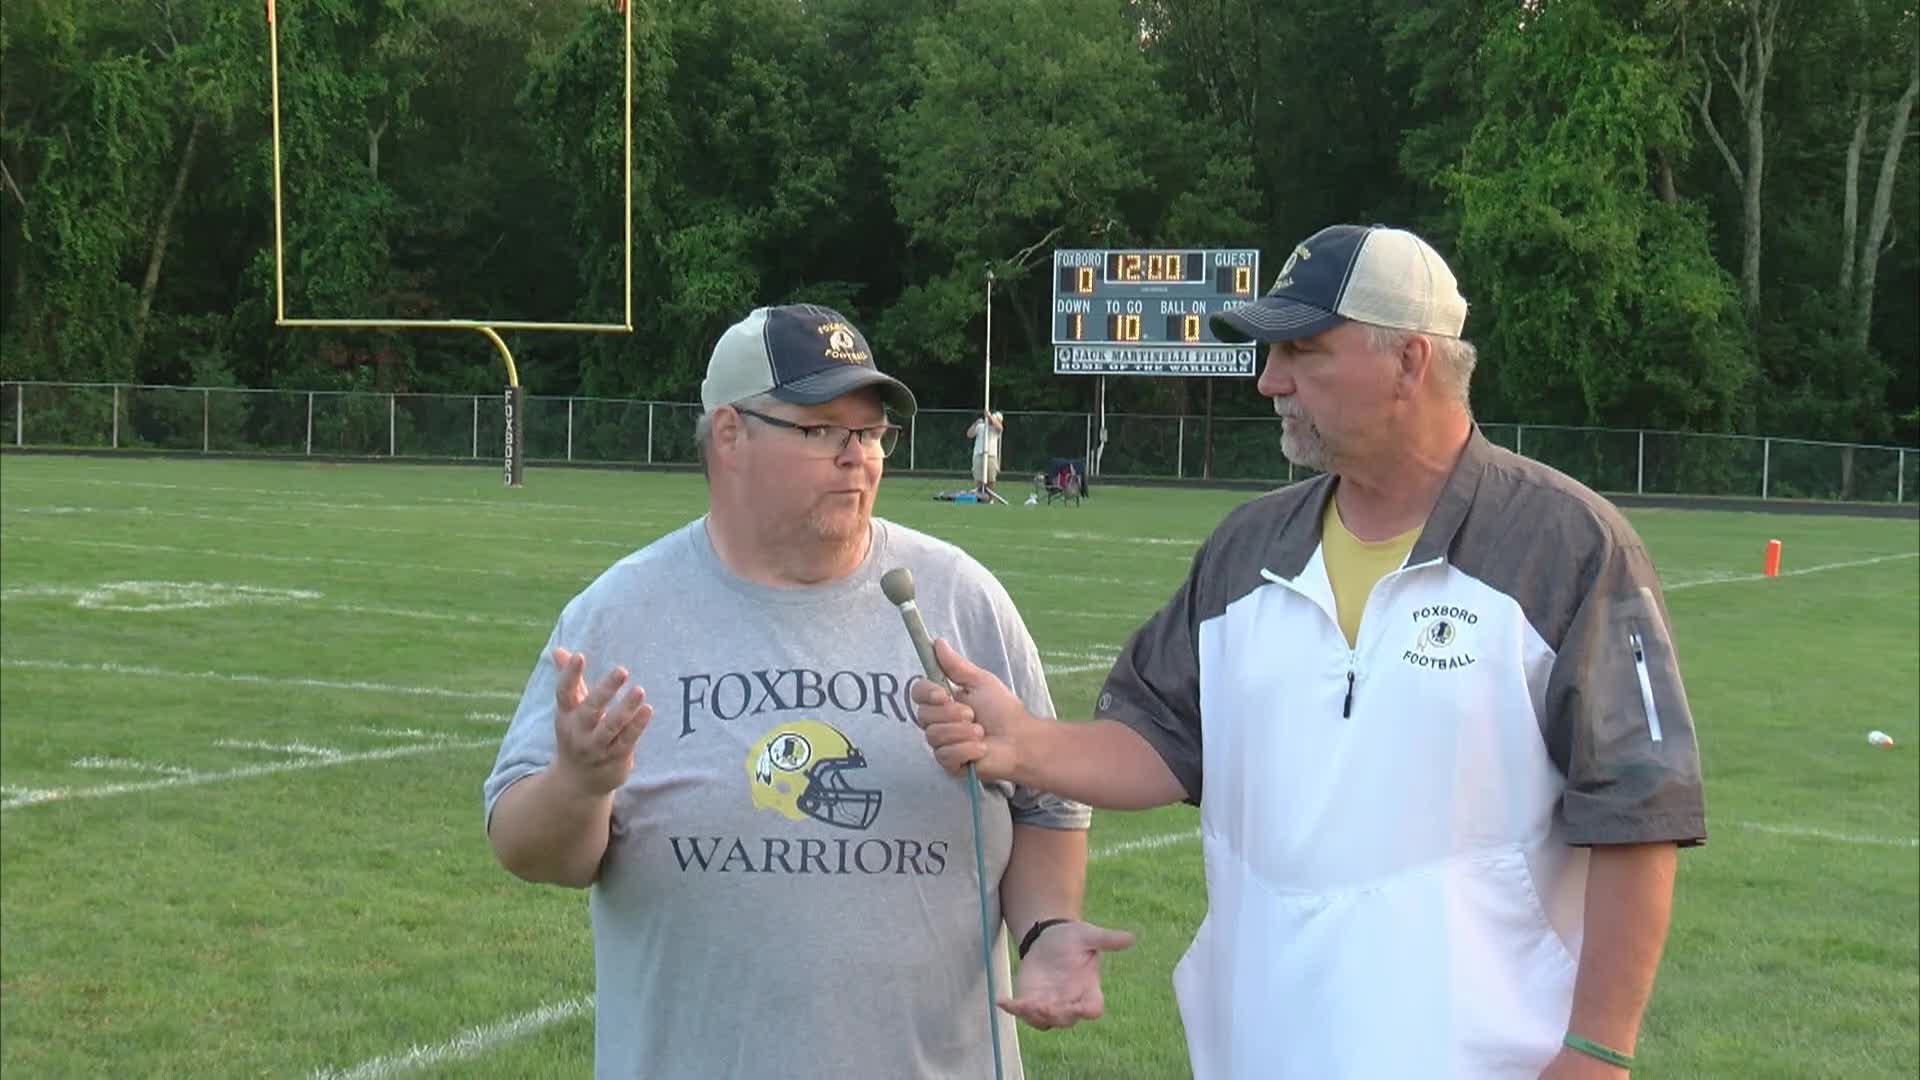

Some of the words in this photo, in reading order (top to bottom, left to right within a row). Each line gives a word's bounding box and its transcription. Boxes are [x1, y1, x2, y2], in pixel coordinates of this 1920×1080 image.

[1057, 253, 1101, 266] FOXBORO
[1117, 255, 1181, 280] 12:00
[1215, 253, 1253, 266] GUEST
[1079, 267, 1093, 293] 0
[1236, 267, 1250, 293] 0
[1057, 300, 1090, 313] DOWN
[1106, 300, 1119, 313] TO
[1127, 300, 1143, 313] GO
[1160, 300, 1185, 314] BALL
[1192, 300, 1206, 314] ON
[1075, 315, 1082, 340] 1
[1117, 315, 1140, 340] 10
[1184, 315, 1200, 341] 0
[1074, 348, 1106, 362] JACK
[1111, 348, 1190, 362] MARTINELLI
[1196, 348, 1235, 362] FIELD
[1061, 362, 1104, 371] HOME
[1109, 362, 1127, 371] OF
[1135, 362, 1163, 371] THE
[1169, 363, 1248, 373] WARRIORS
[504, 391, 513, 486] FOXBORO
[1412, 605, 1478, 625] FOXBORO
[1402, 649, 1476, 670] FOOTBALL
[669, 836, 948, 875] WARRIORS
